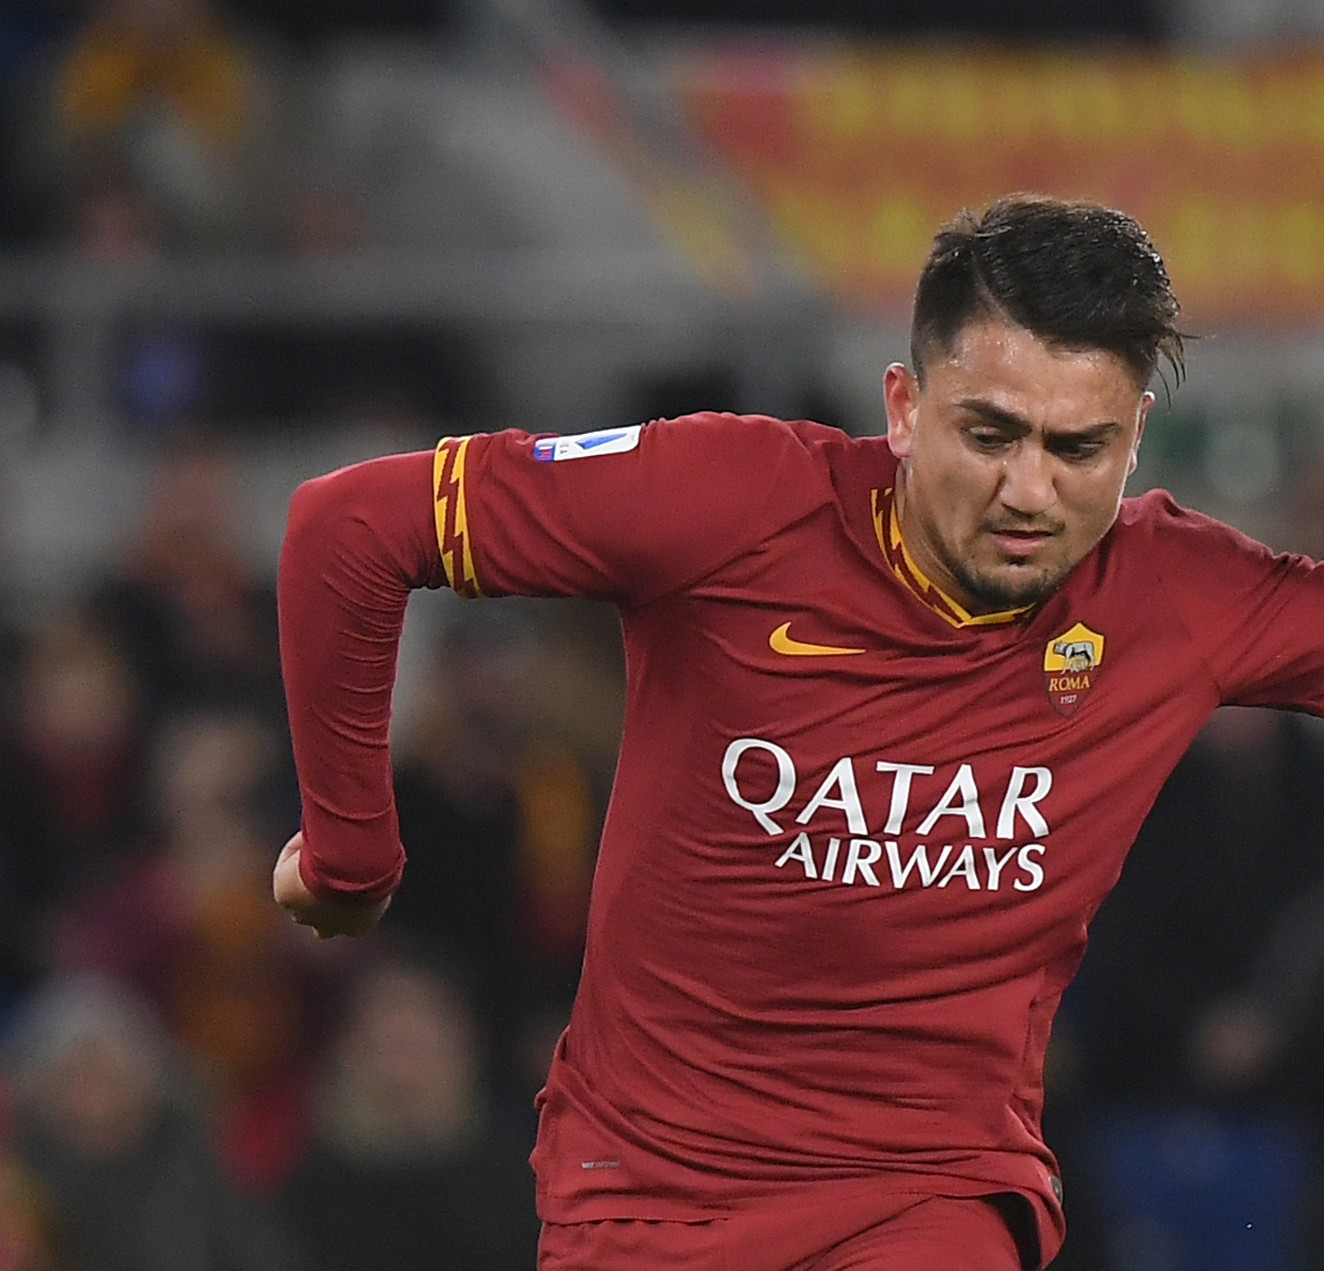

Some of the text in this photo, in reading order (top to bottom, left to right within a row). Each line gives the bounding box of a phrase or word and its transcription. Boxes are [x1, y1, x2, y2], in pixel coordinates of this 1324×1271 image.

[1048, 675, 1091, 692] ROMA
[721, 737, 1053, 840] QATAR
[775, 831, 1046, 892] AIRWAYS
